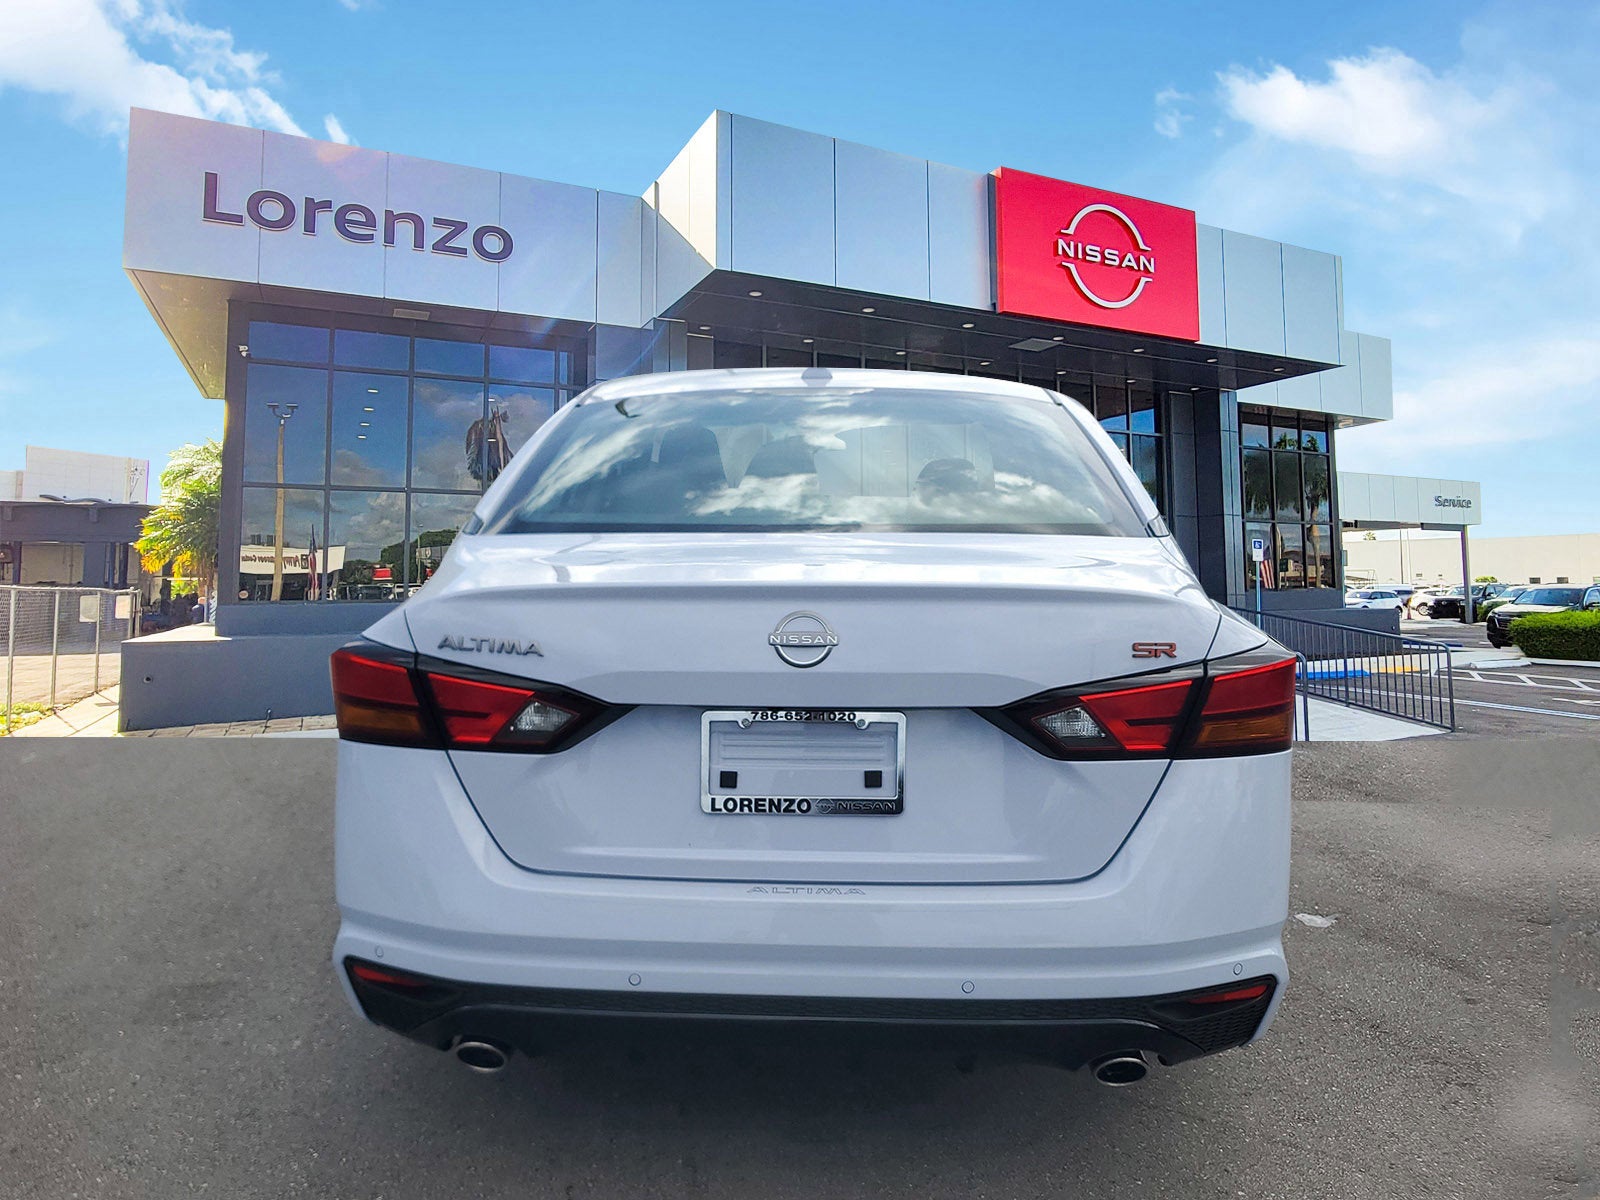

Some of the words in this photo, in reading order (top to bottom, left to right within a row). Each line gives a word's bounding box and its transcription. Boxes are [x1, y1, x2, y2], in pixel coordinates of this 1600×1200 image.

[203, 171, 514, 263] Lorenzo
[1057, 238, 1155, 273] NISSAN
[1434, 495, 1472, 508] Service
[438, 634, 544, 657] ALTIMA
[769, 635, 838, 644] NISSAN
[1132, 642, 1177, 658] SR
[750, 711, 857, 721] 786-652-1020
[710, 797, 812, 813] LORENZO
[836, 801, 896, 811] NISSAN
[746, 886, 866, 896] ALTIMA
